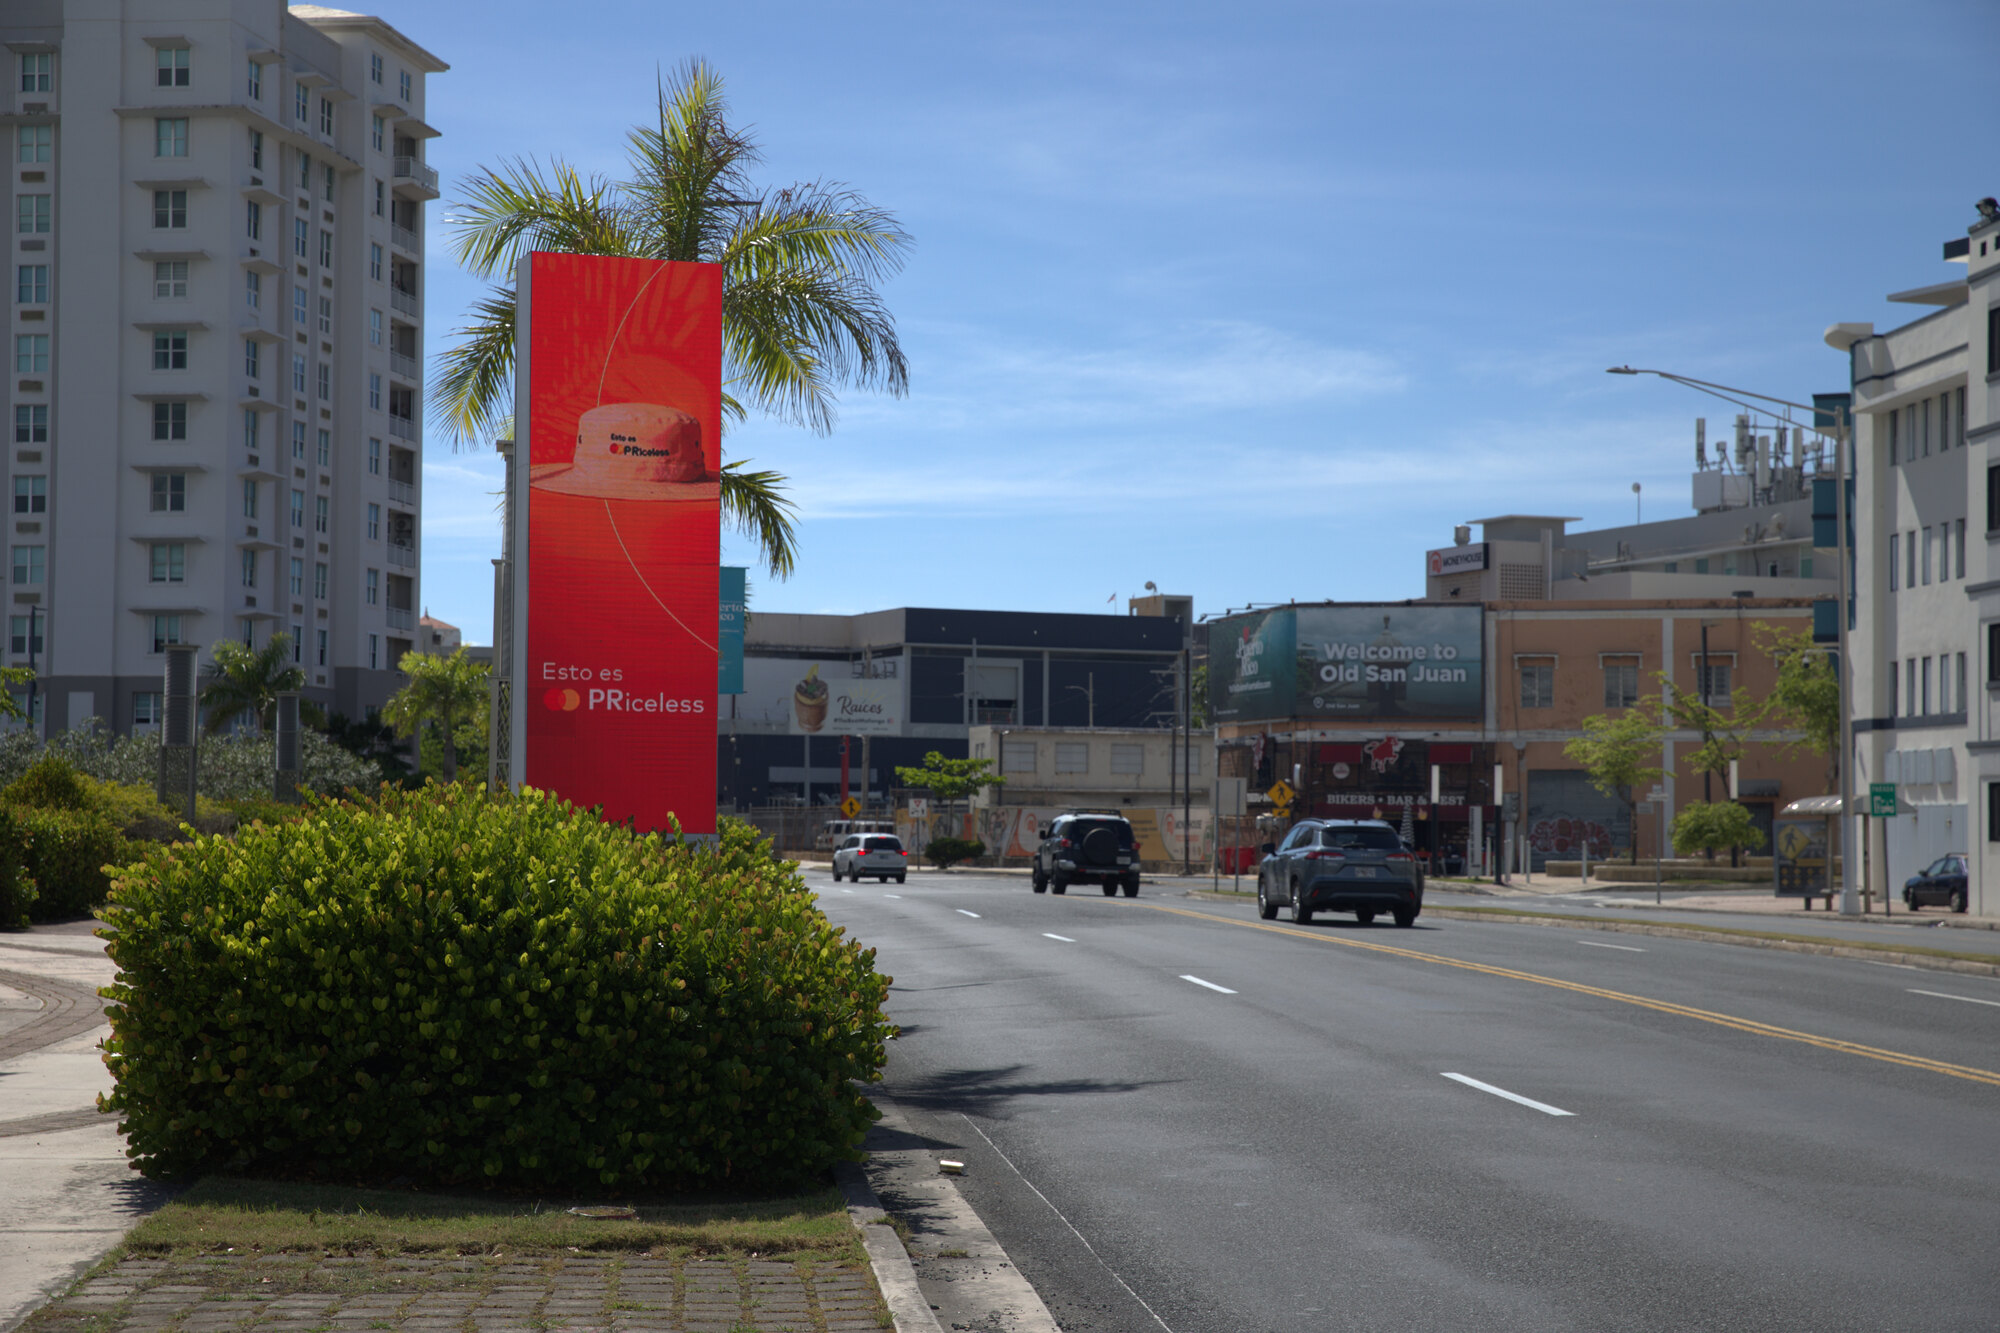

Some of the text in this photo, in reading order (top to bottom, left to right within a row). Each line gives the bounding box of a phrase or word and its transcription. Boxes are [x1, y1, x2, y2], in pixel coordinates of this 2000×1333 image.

[611, 433, 626, 442] Esto
[624, 446, 669, 456] PRiceless
[1324, 642, 1457, 660] Welcome to
[542, 662, 623, 681] Esto es
[1320, 664, 1467, 682] Old San Juan
[588, 688, 705, 713] PRiceless
[1327, 794, 1465, 806] BIKERS BAR & EST
